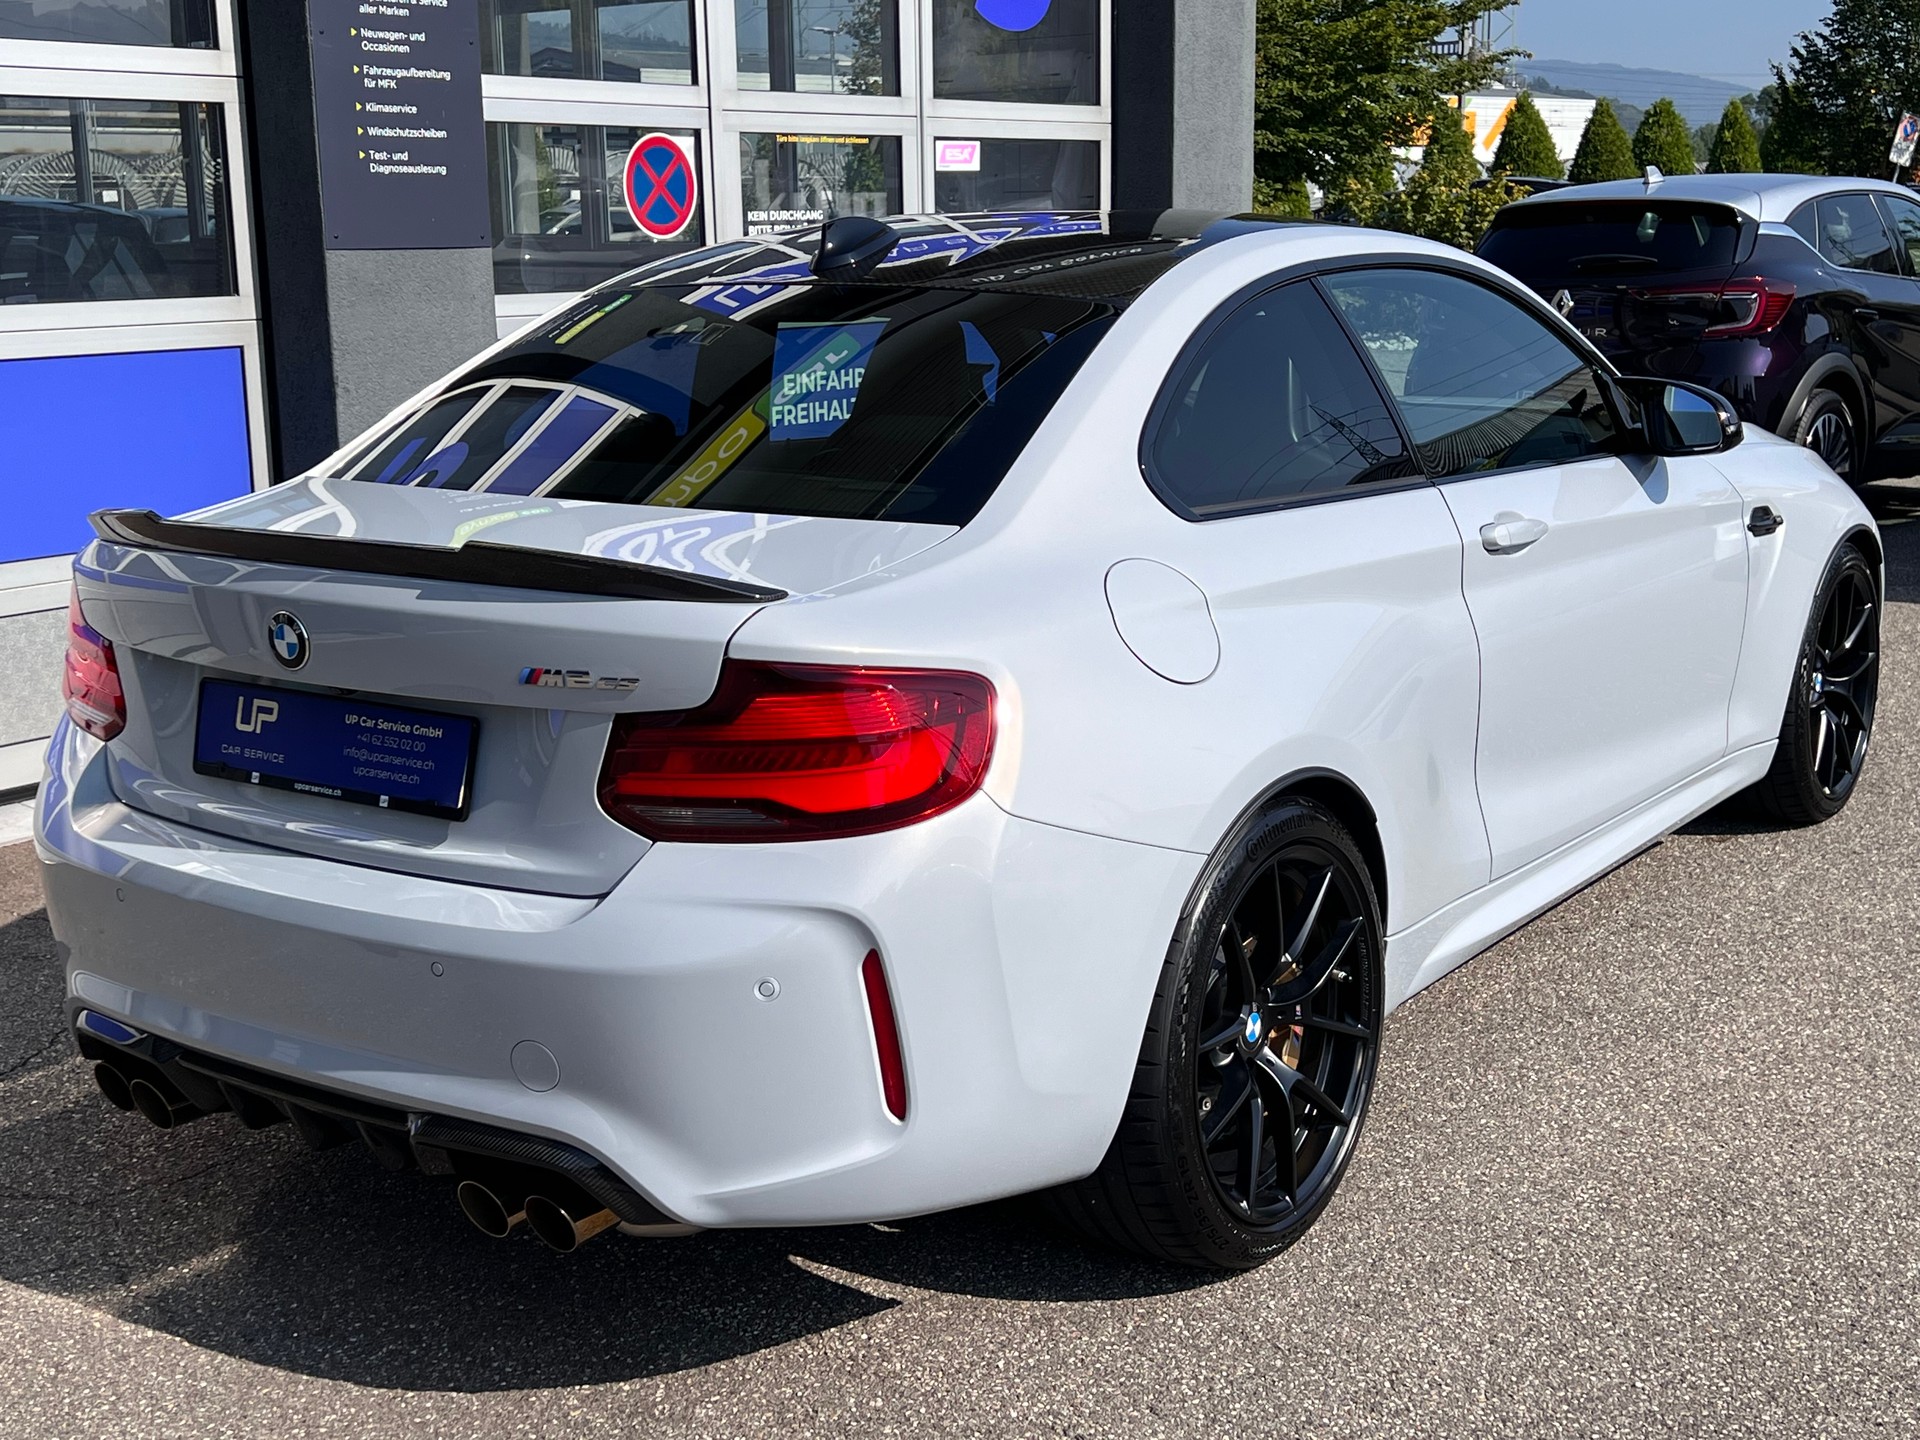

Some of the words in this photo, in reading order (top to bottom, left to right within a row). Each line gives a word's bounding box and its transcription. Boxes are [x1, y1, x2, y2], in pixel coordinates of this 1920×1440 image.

[359, 4, 377, 14] aller
[378, 7, 410, 17] Marken
[360, 28, 408, 42] Neuwagen-
[409, 32, 426, 42] und
[361, 42, 410, 53] Occasionen
[363, 65, 451, 81] Fahrzeugaufbereitung
[364, 78, 376, 88] für
[377, 79, 398, 89] MFK
[365, 102, 418, 114] Klimaservice
[367, 126, 448, 138] Windschutzscheiben
[369, 150, 391, 160] Test-
[392, 151, 409, 161] und
[370, 163, 448, 176] Diagnoseauslesung
[747, 211, 769, 222] KEIN
[769, 210, 824, 221] DURCHGANG
[771, 397, 857, 427] FREIHAL
[235, 696, 279, 734] UP
[345, 714, 359, 725] UP
[360, 716, 376, 728] Car
[377, 719, 411, 733] Service
[413, 724, 444, 738] GmbH
[357, 733, 371, 743] +41
[371, 734, 383, 746] 62
[384, 736, 400, 748] 552
[400, 739, 413, 750] 02
[413, 740, 427, 752] 00
[221, 744, 241, 755] CAR
[244, 748, 285, 764] SERVICE
[343, 746, 435, 770] info@upcarservice.ch
[353, 766, 421, 785] upcarservice.ch
[294, 782, 342, 797] upcarservice.ch
